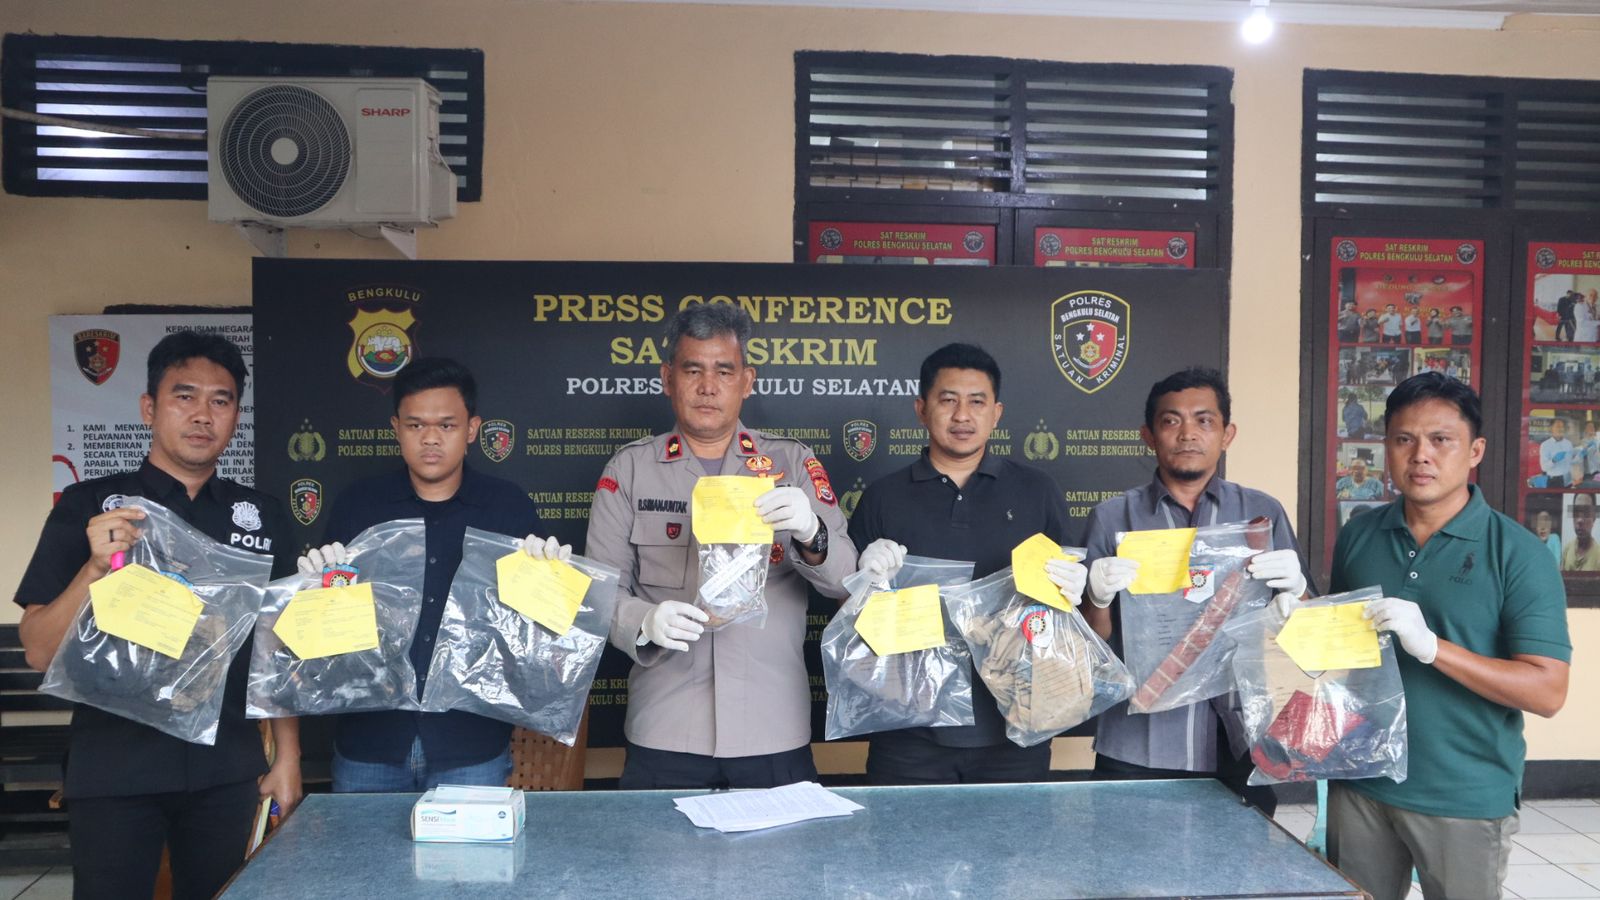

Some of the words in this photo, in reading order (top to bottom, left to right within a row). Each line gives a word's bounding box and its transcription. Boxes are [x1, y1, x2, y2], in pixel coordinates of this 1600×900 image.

[361, 107, 411, 117] SHARP
[880, 231, 892, 240] SAT
[895, 231, 926, 240] RESKRIM
[1092, 236, 1106, 246] SAT
[854, 240, 880, 249] POLRES
[882, 240, 920, 250] BENGKULU
[922, 241, 953, 251] SELATAN
[1385, 243, 1398, 252] SAT
[1065, 246, 1092, 256] POLRES
[1133, 247, 1164, 258] SELATAN
[1360, 252, 1385, 261] POLRES
[1387, 253, 1423, 262] BENGKULU
[1424, 254, 1453, 263] SELATAN
[347, 287, 421, 302] BENGKULU
[1069, 296, 1113, 309] POLRES
[533, 294, 665, 323] PRESS
[1060, 307, 1094, 323] BENGKULU
[1094, 307, 1121, 324] SELATAN
[1054, 333, 1084, 384] SATUAN
[1095, 334, 1126, 384] KRIMINAL
[566, 377, 664, 395] POLRES
[83, 424, 106, 432] KAMI
[787, 428, 831, 439] KRIMINAL
[83, 433, 131, 441] PELAYANAN
[338, 429, 375, 440] SATUAN
[527, 428, 563, 440] SATUAN
[566, 428, 607, 439] RESERSE
[889, 428, 924, 440] SATUAN
[1066, 429, 1099, 440] SATUAN
[1102, 429, 1141, 440] RESERSE
[83, 442, 142, 450] MEMBERIKAN
[338, 445, 373, 456] POLRES
[526, 444, 561, 456] POLRES
[564, 444, 612, 456] BENGKULU
[889, 444, 922, 456] POLRES
[1065, 445, 1098, 456] POLRES
[1100, 445, 1145, 456] BENGKULU
[84, 451, 116, 459] SECARA
[118, 450, 146, 458] TERUS
[84, 460, 119, 468] APABILA
[233, 459, 245, 467] INI
[1066, 491, 1099, 502] SATUAN
